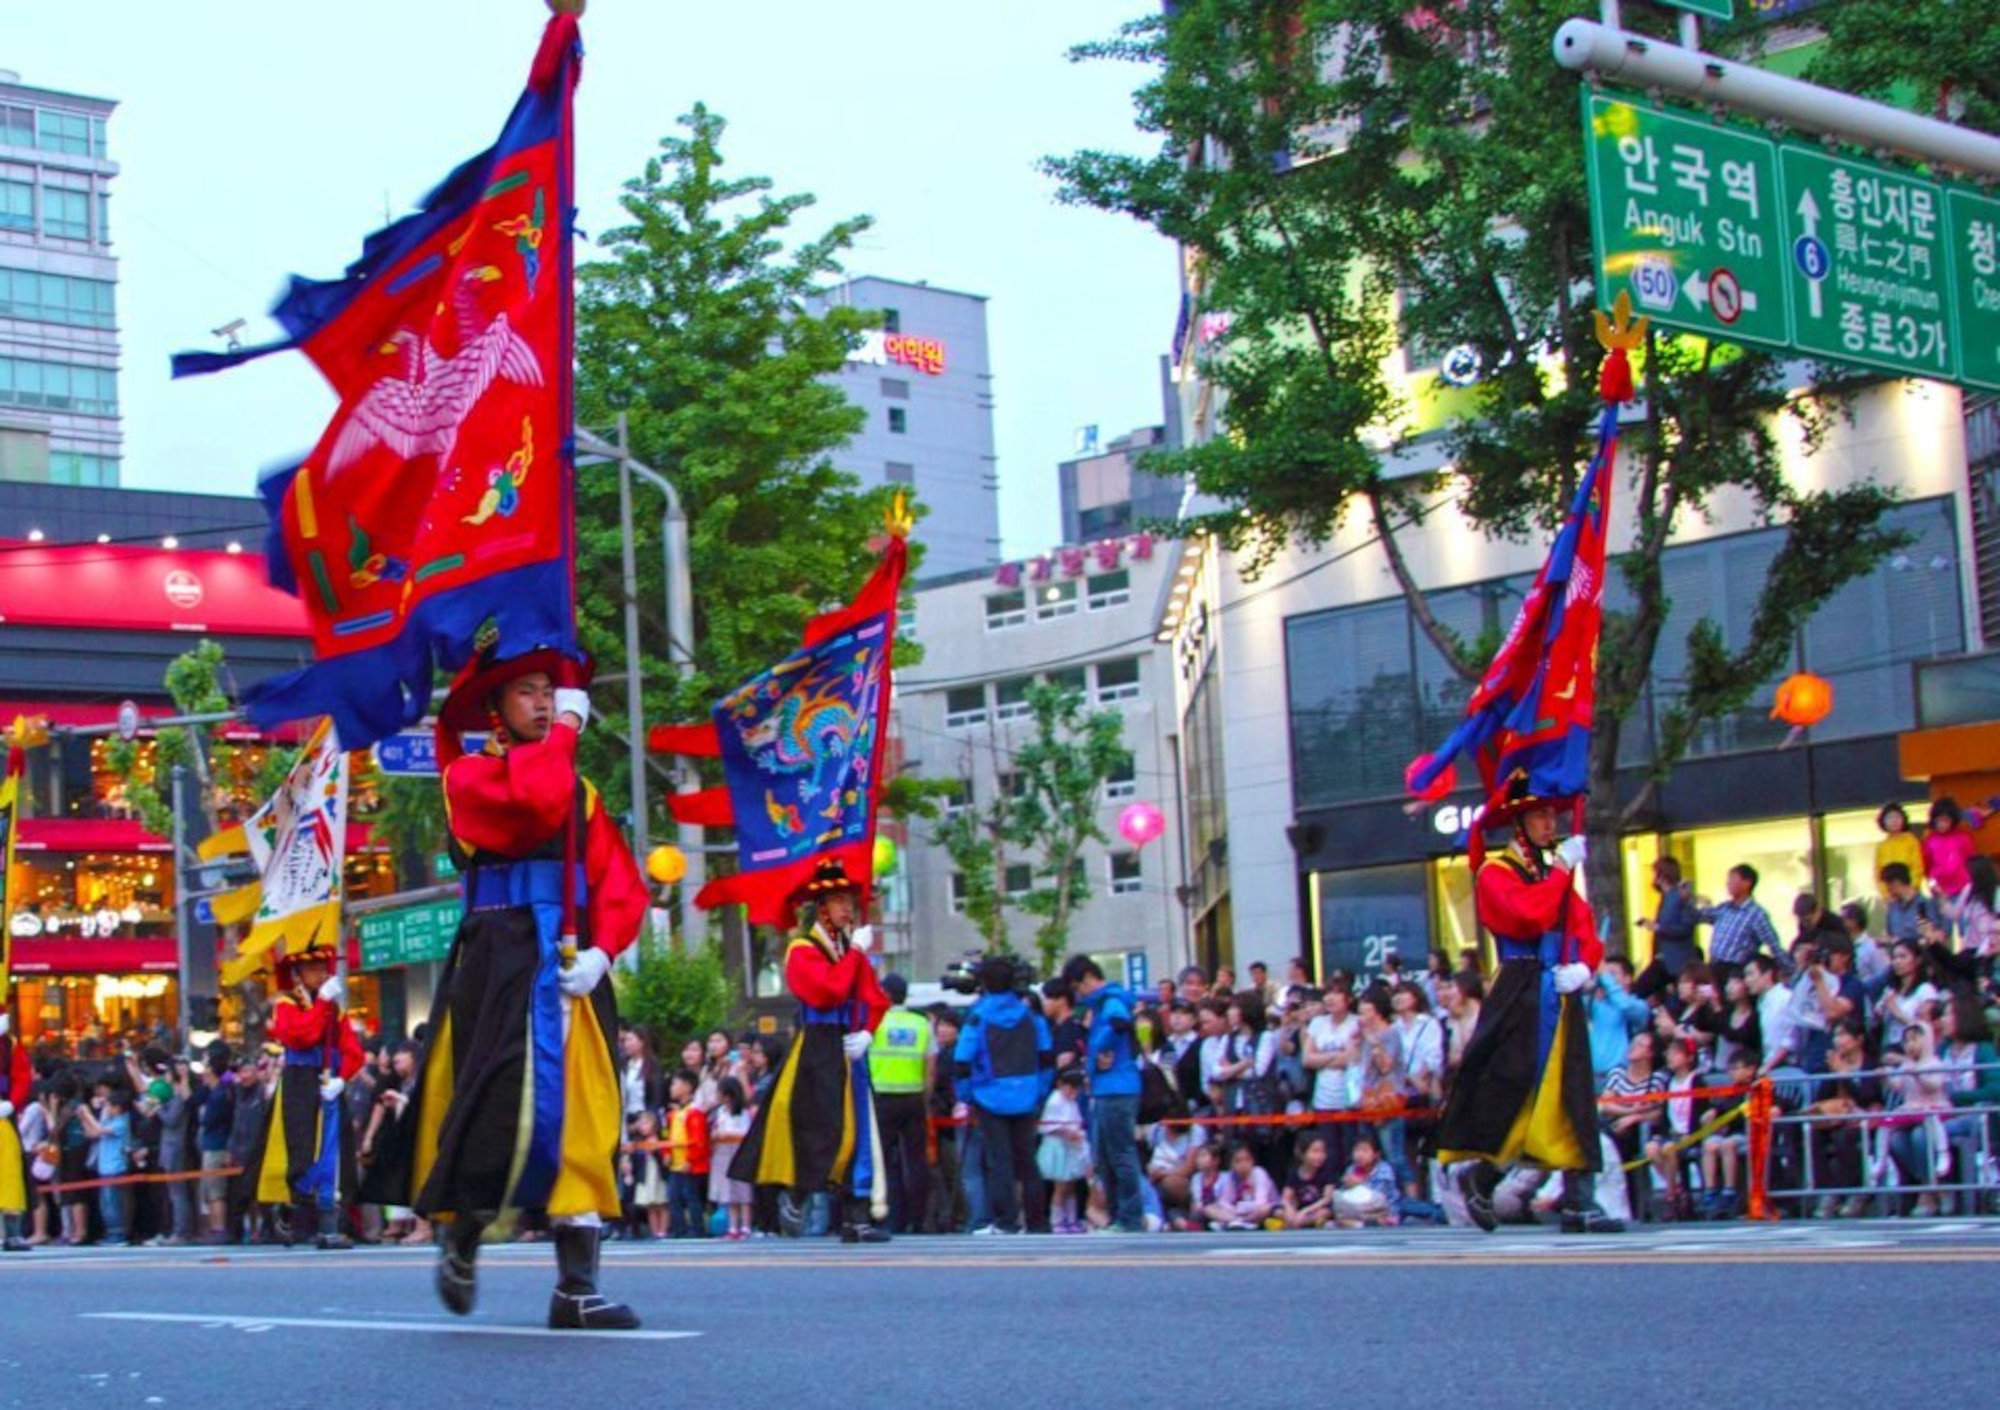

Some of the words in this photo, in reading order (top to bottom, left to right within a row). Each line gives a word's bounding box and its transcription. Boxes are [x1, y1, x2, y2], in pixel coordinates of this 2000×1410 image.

[1618, 136, 1759, 219] 안국역
[1828, 168, 1936, 240] 흥인지문
[1624, 197, 1705, 247] Anguk
[1717, 217, 1763, 259] Stn
[1804, 241, 1820, 275] 6
[1967, 219, 2000, 275] 청
[1641, 267, 1669, 298] 50
[1840, 301, 1947, 368] 종로3가
